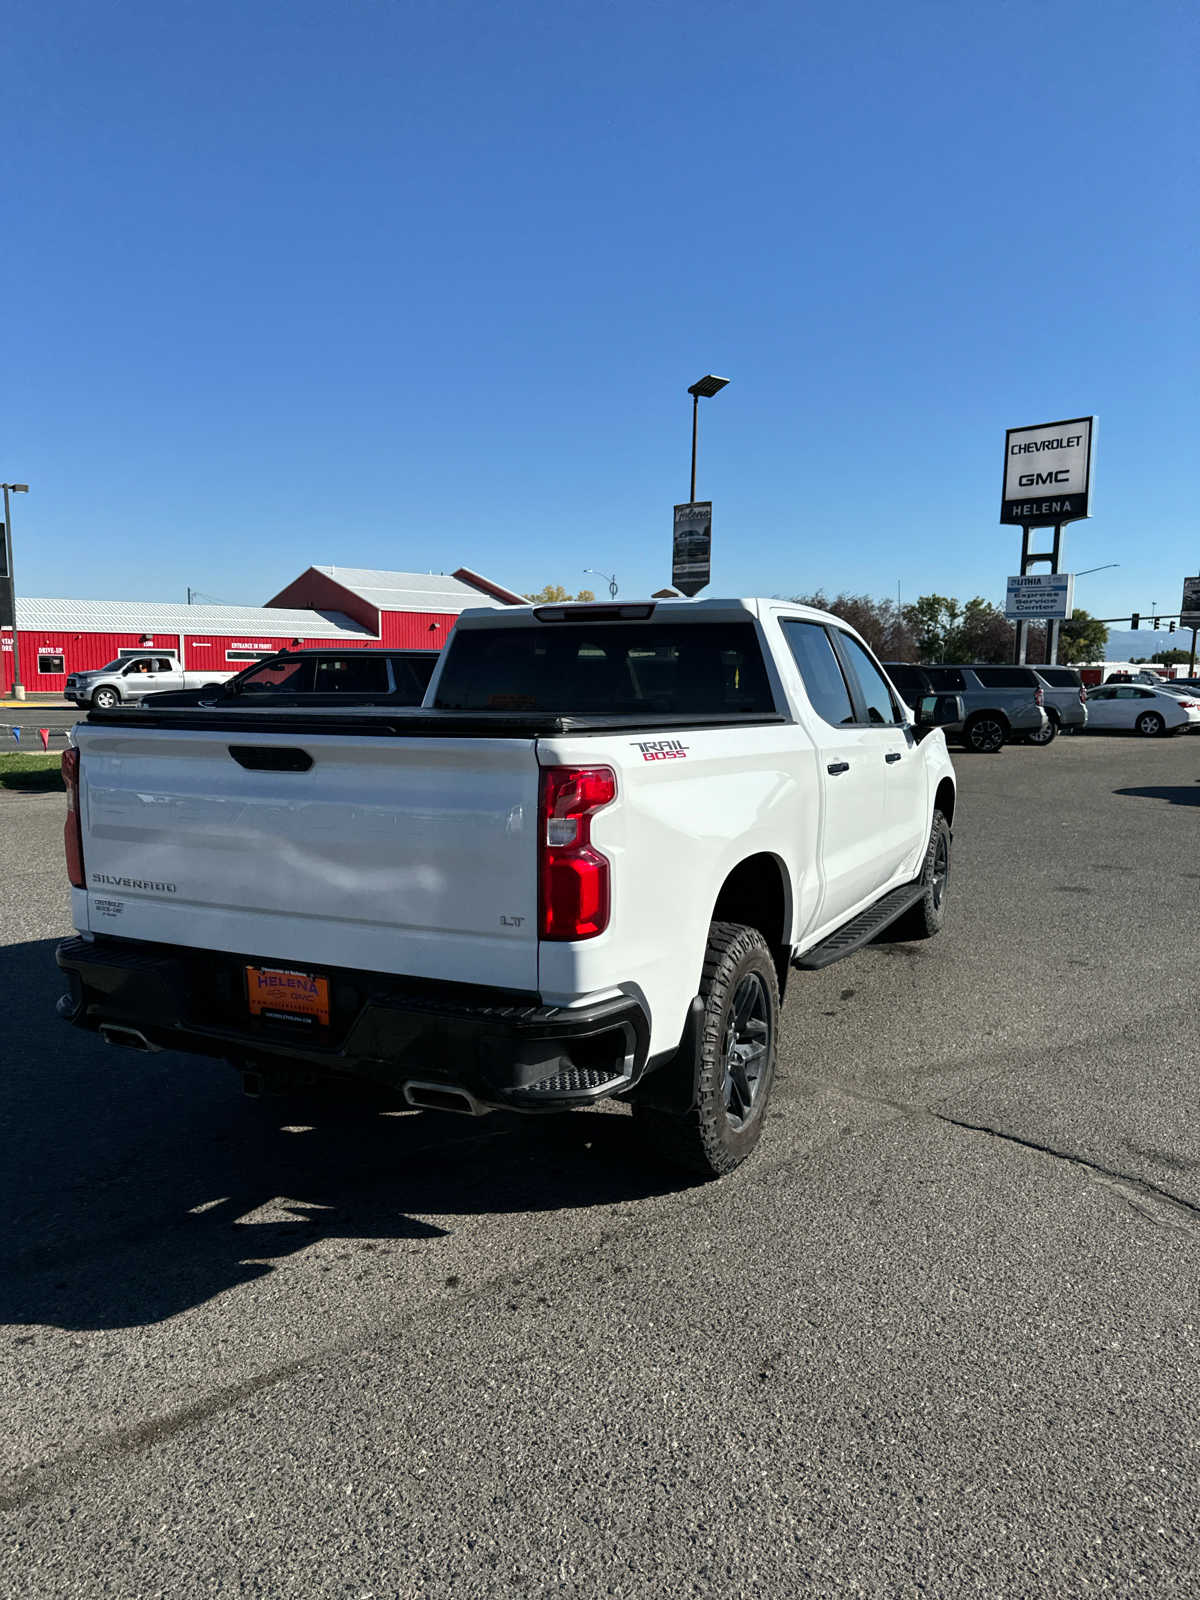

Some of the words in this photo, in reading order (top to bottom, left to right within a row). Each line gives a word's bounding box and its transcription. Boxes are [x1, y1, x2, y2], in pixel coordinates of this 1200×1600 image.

[1011, 435, 1083, 456] CHEVROLET
[1018, 469, 1070, 487] GMC
[1012, 501, 1072, 516] HELENA
[1016, 577, 1042, 586] LITHIA
[1014, 592, 1060, 600] Express
[629, 740, 690, 753] TRAIL
[642, 750, 687, 761] BOSS
[499, 915, 525, 928] LT
[258, 975, 319, 996] HELENA
